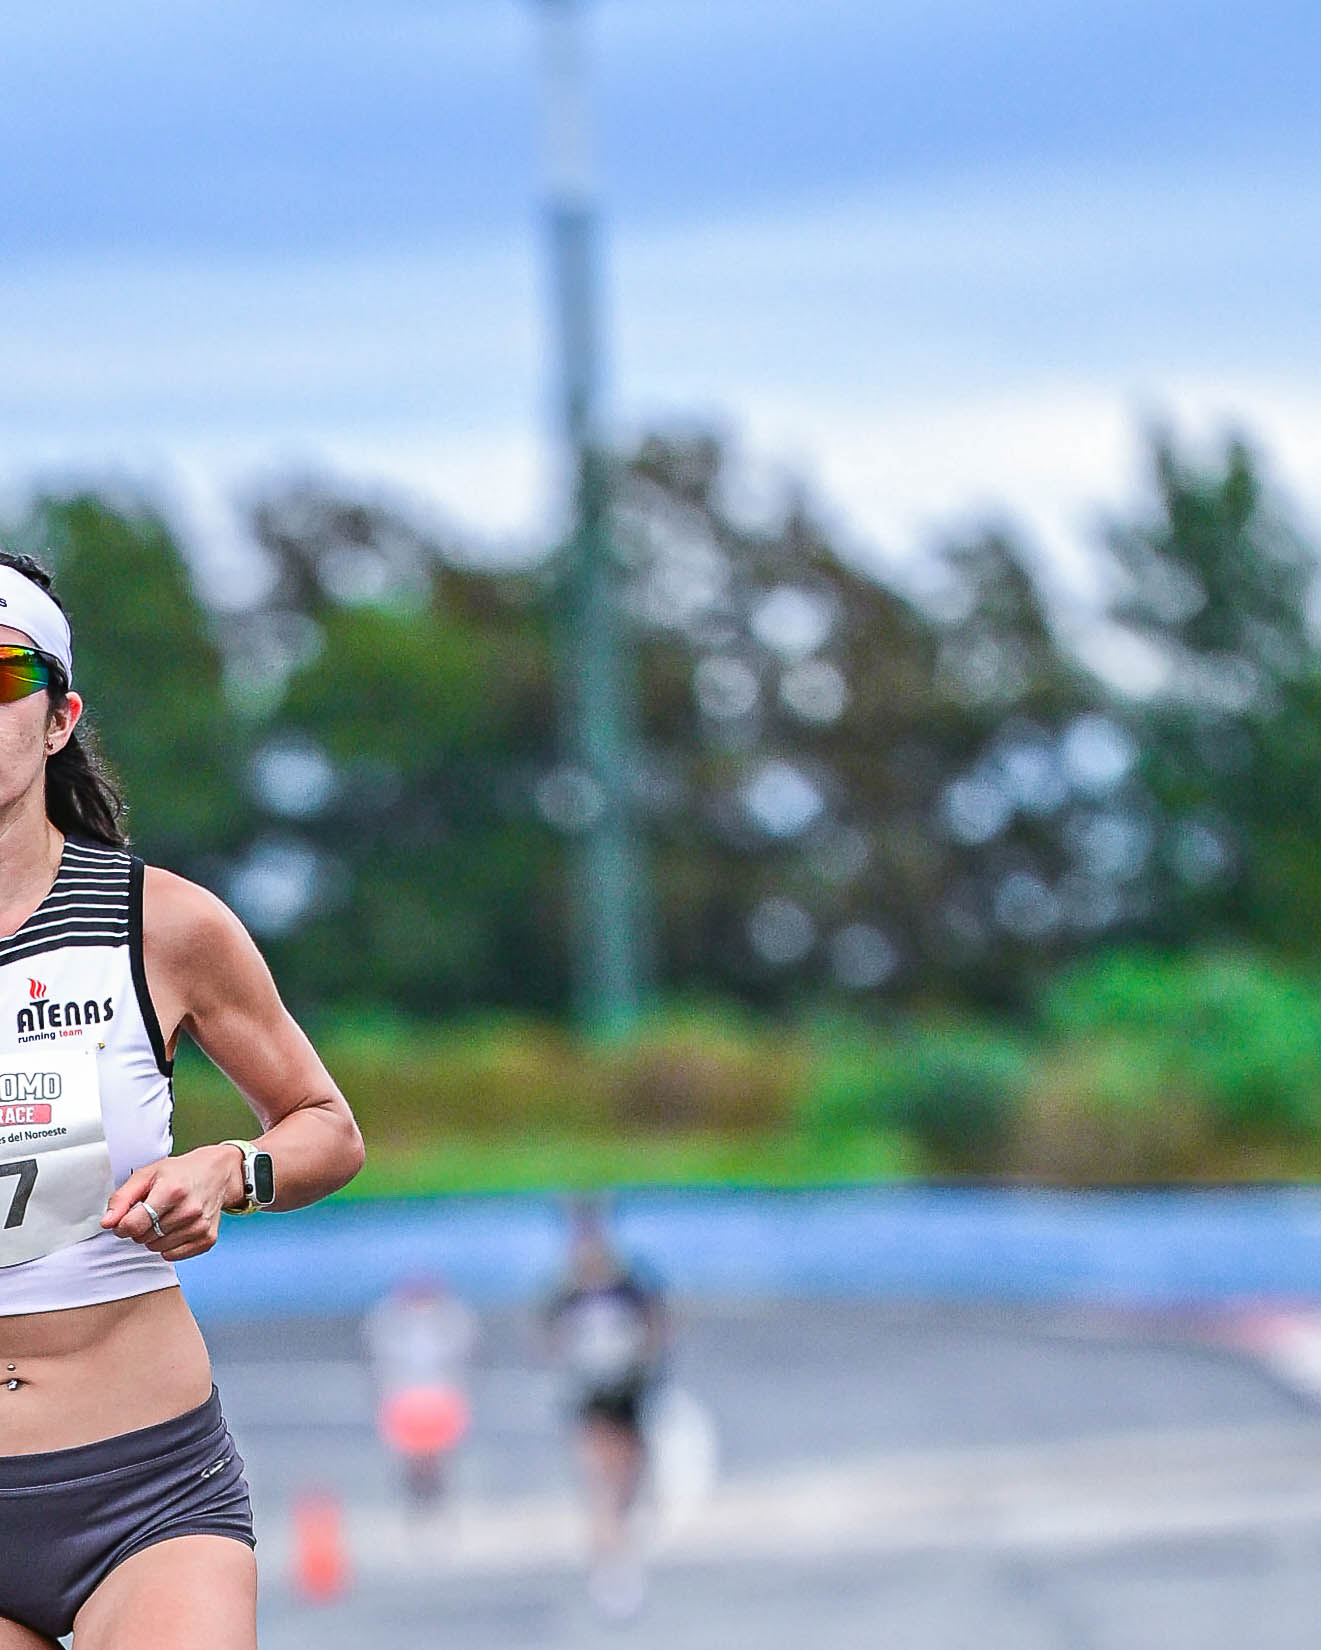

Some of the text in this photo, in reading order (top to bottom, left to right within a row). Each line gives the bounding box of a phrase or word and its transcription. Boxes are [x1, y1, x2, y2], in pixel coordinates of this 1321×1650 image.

[16, 997, 114, 1034] ATENAS
[18, 1028, 83, 1043] running team
[8, 1131, 23, 1143] del
[24, 1126, 67, 1141] Noroeste
